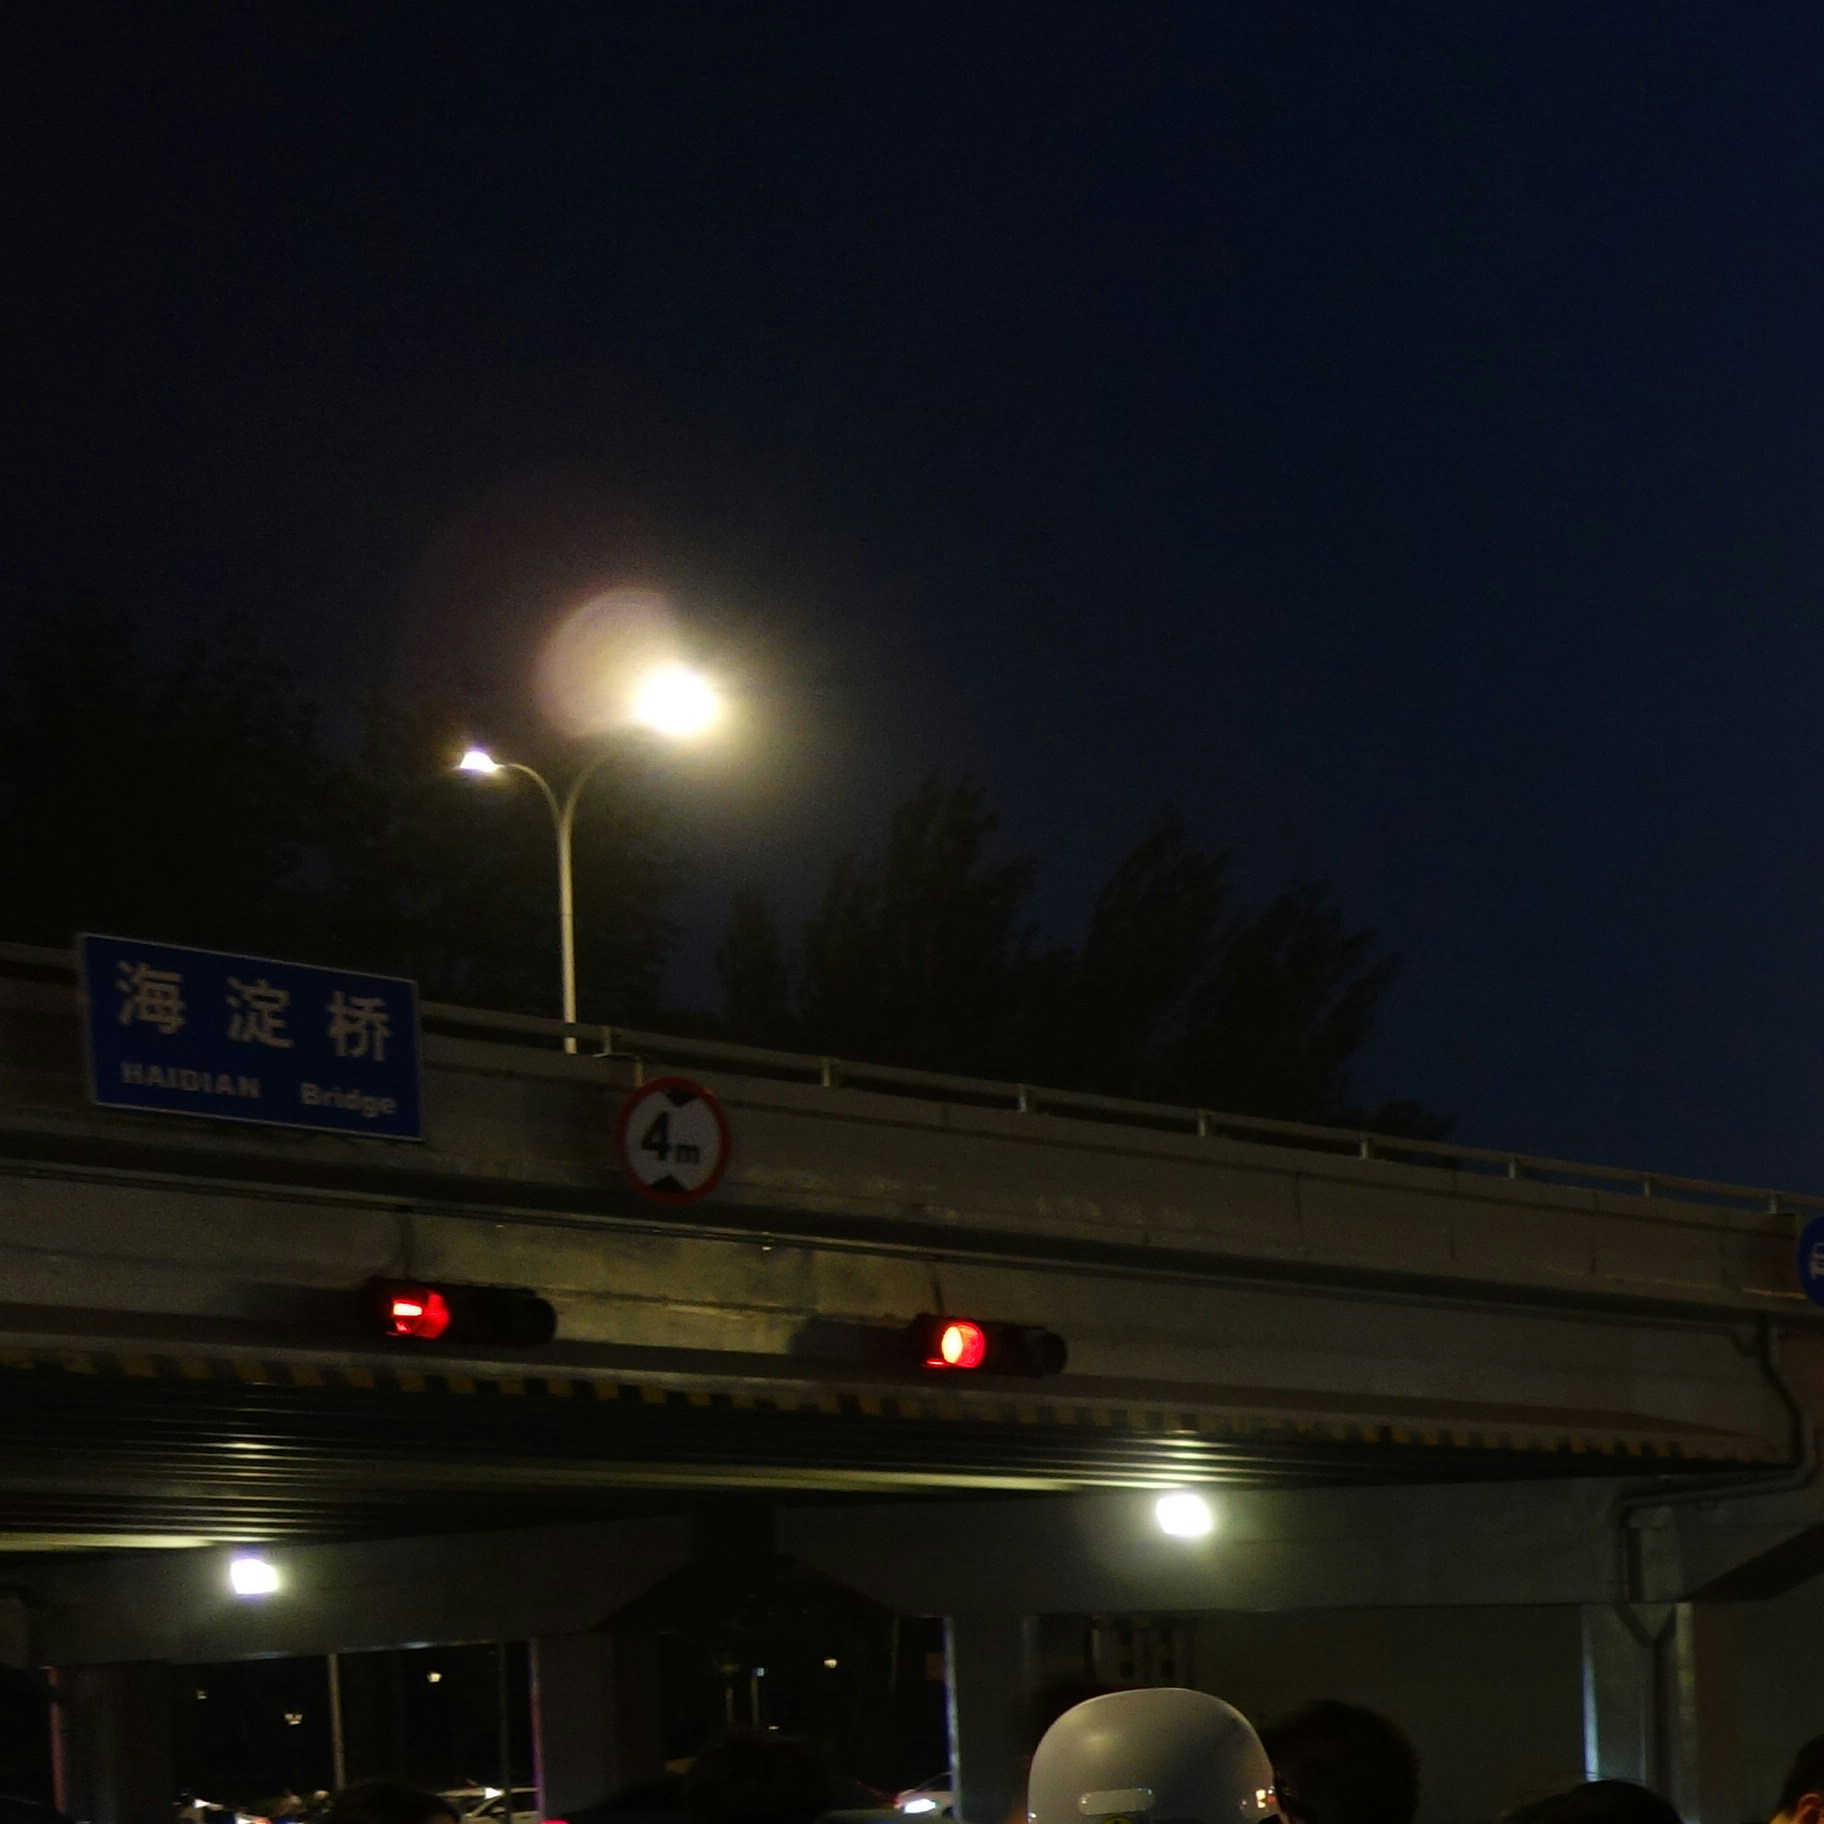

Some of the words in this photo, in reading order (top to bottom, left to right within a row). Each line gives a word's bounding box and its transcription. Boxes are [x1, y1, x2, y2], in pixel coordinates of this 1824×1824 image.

[114, 959, 393, 1062] 海淀桥
[120, 1060, 263, 1099] HAIDIAN
[298, 1080, 399, 1119] Bridge
